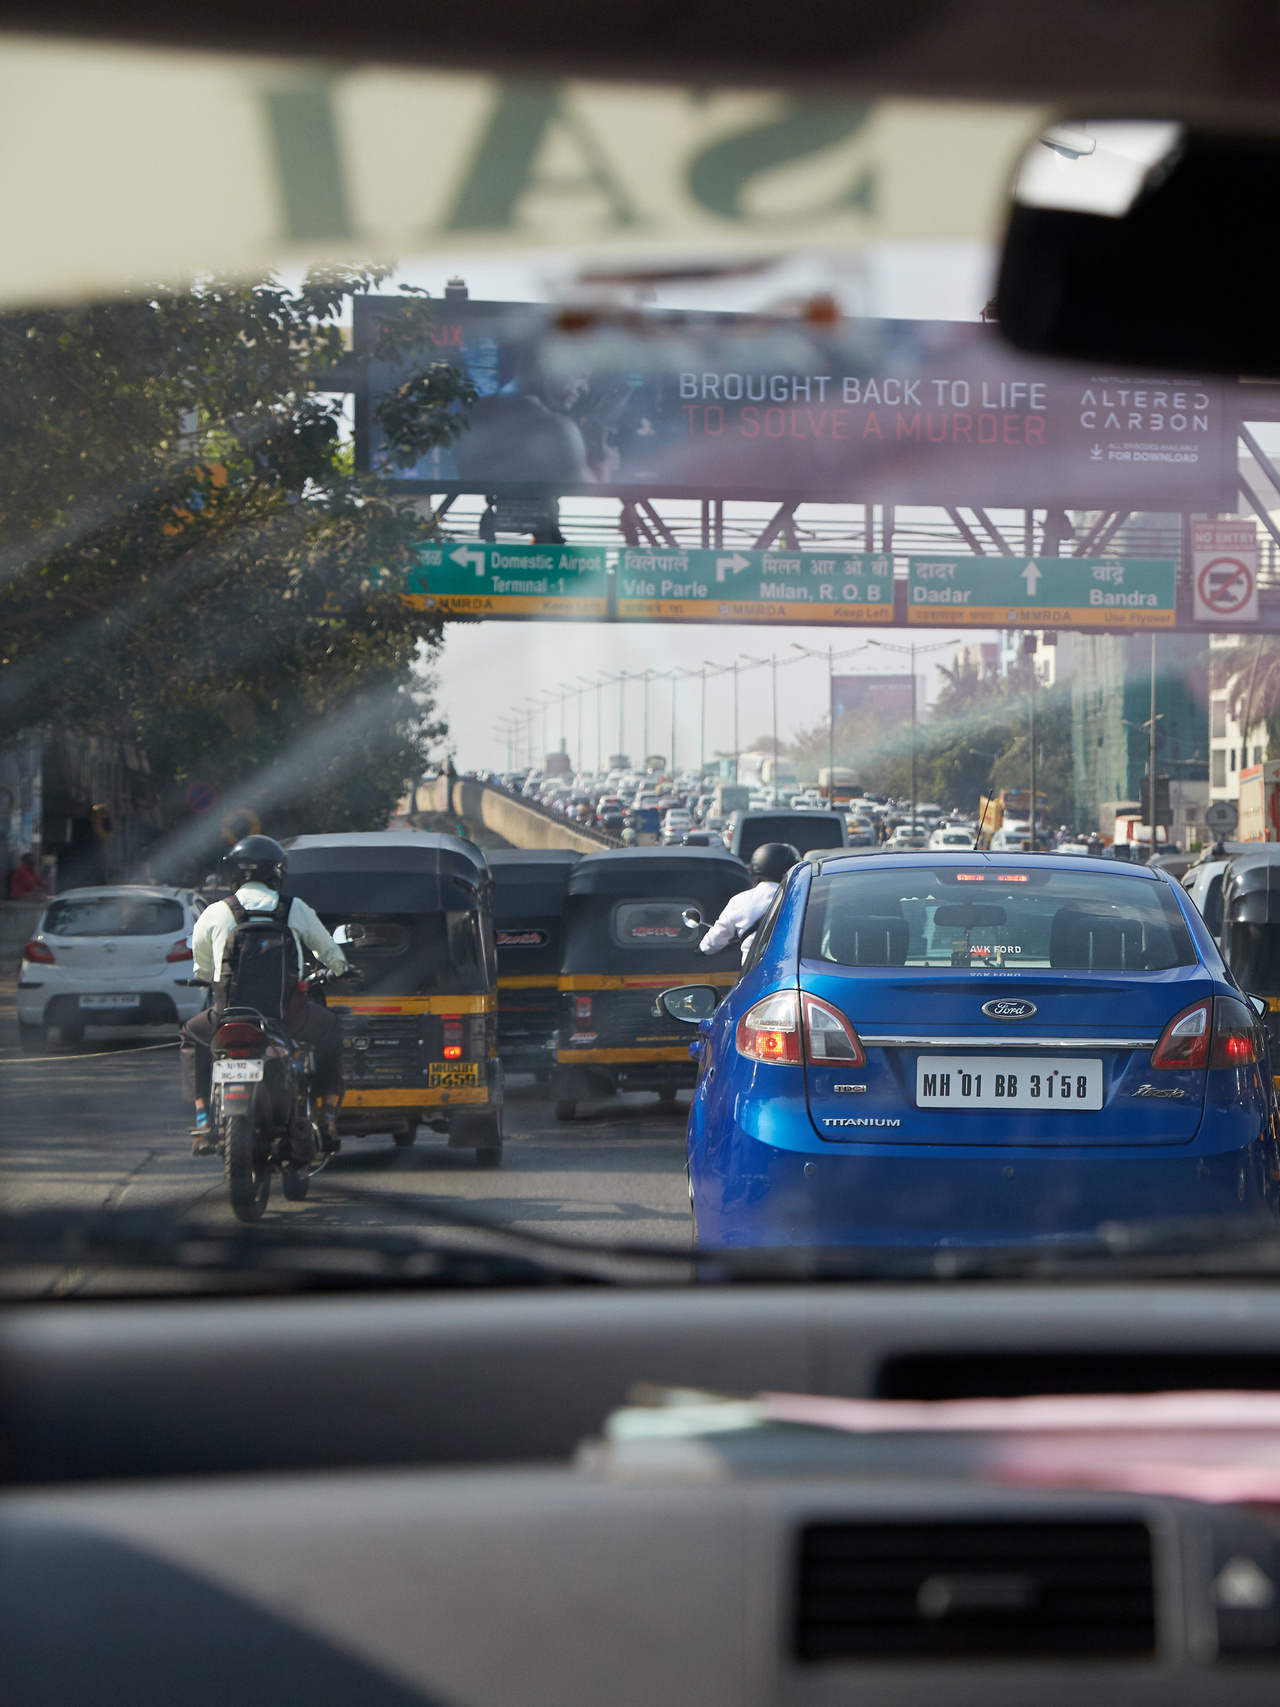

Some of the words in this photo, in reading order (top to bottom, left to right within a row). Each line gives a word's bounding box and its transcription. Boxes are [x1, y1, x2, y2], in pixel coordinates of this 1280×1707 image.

[679, 372, 832, 402] BROUGHT
[842, 376, 922, 406] BACK
[931, 379, 969, 407] TO
[982, 381, 1047, 410] LIFE
[1080, 389, 1209, 410] ALTERED
[681, 404, 724, 436] TO
[740, 406, 849, 439] SOLVE
[862, 411, 883, 440] A
[897, 411, 1045, 445] MURDER
[1080, 410, 1208, 432] CARBON
[1108, 451, 1131, 461] FOR
[1133, 452, 1199, 463] DOWNLOAD
[1195, 531, 1212, 543] NO
[1215, 532, 1256, 543] ENTRY
[491, 551, 553, 569] Domestic
[761, 553, 801, 575] मिलन
[915, 562, 958, 579] दादर
[492, 576, 547, 594] Terminal
[622, 579, 655, 596] Vile
[660, 579, 708, 598] Parle
[867, 585, 882, 601] B
[913, 586, 971, 604] Dadar
[1089, 588, 1158, 606] Bandra
[438, 598, 493, 609] MMRDA
[733, 604, 786, 616] MMRDA
[833, 606, 864, 619] Keep
[866, 607, 890, 619] Left
[1020, 610, 1072, 622] MMRDA
[1104, 612, 1125, 623] Use
[1129, 612, 1171, 625] Flyover
[970, 945, 991, 953] AVK
[993, 945, 1022, 954] FORD
[994, 1002, 1025, 1015] Ford
[923, 1073, 951, 1097] MH
[961, 1074, 982, 1097] 01
[994, 1074, 1018, 1098] BB
[1030, 1075, 1088, 1099] 3158
[1131, 1084, 1185, 1098] Fiesta
[822, 1118, 901, 1128] TITANIUM
